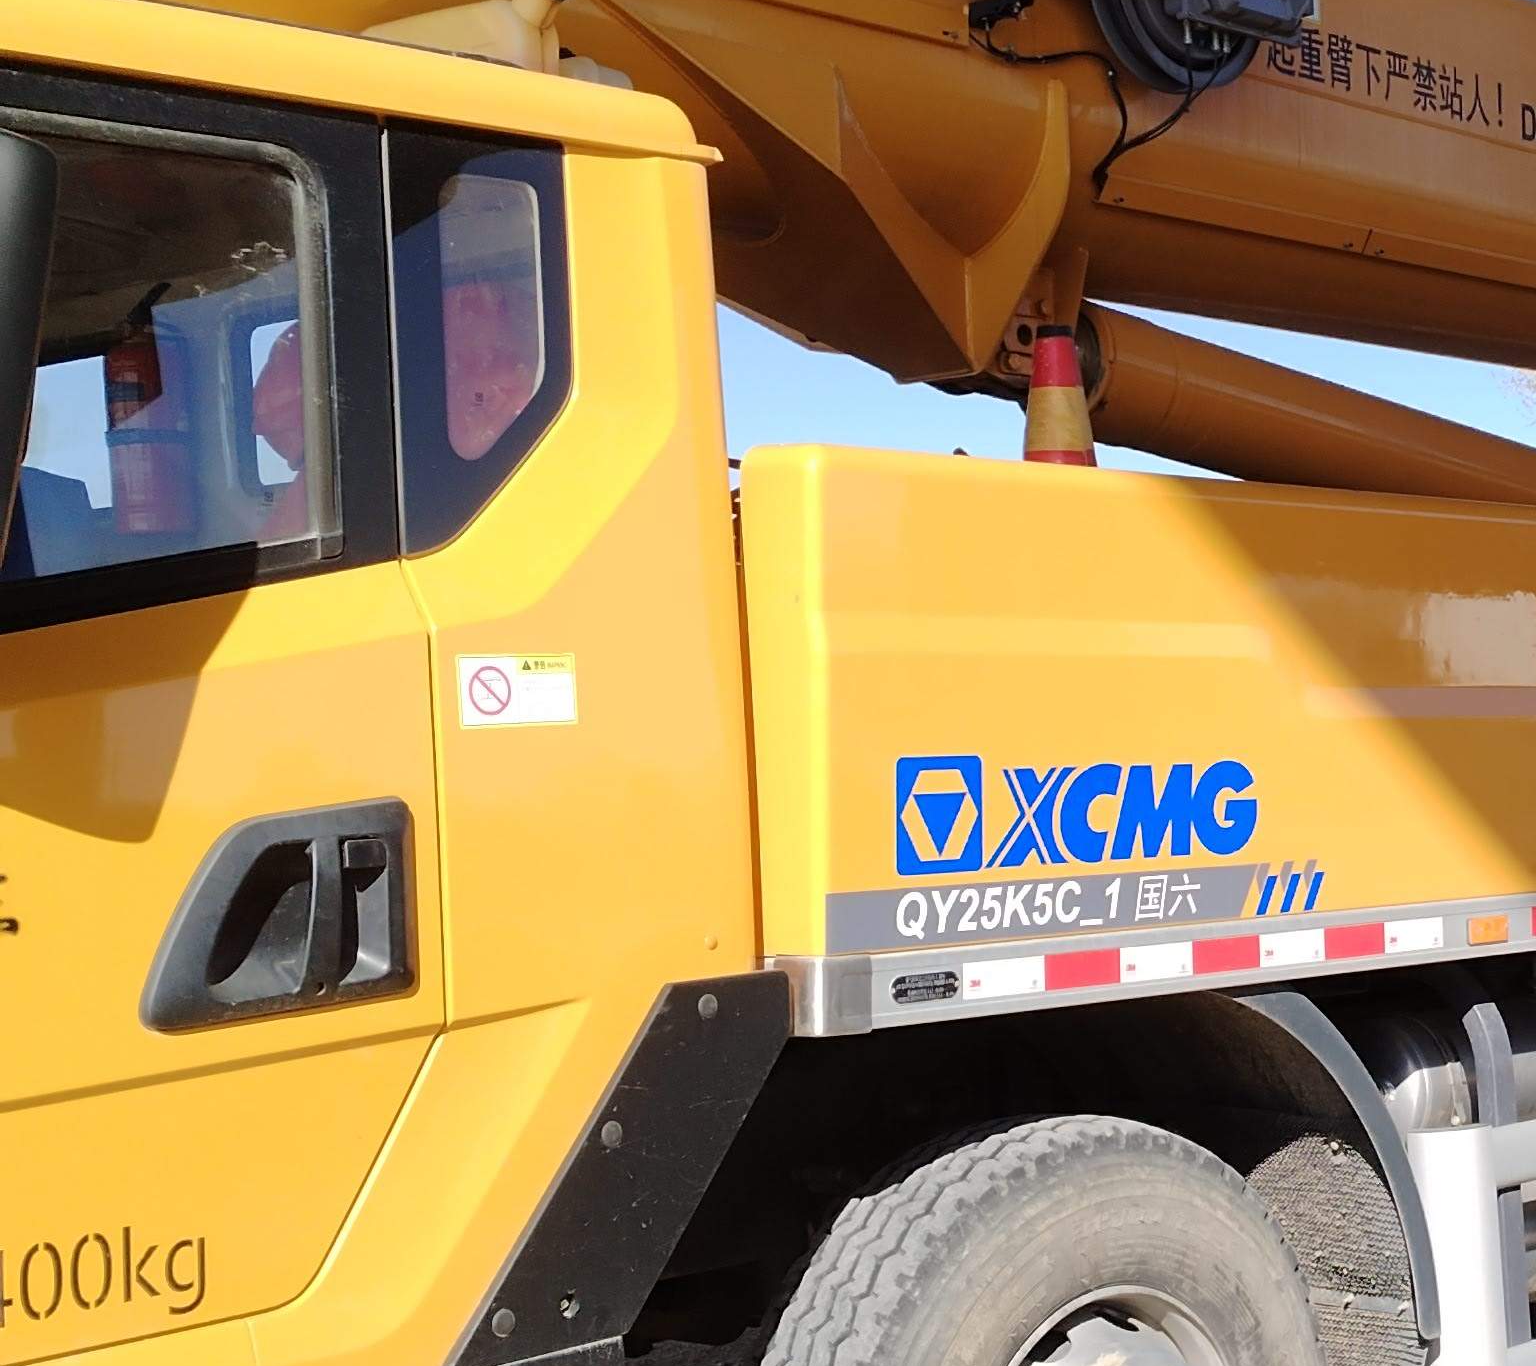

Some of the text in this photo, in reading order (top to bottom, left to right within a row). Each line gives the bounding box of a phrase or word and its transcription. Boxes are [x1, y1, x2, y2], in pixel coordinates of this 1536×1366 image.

[985, 760, 1258, 869] XCMG
[896, 873, 1201, 940] QY25K5C_1 国六
